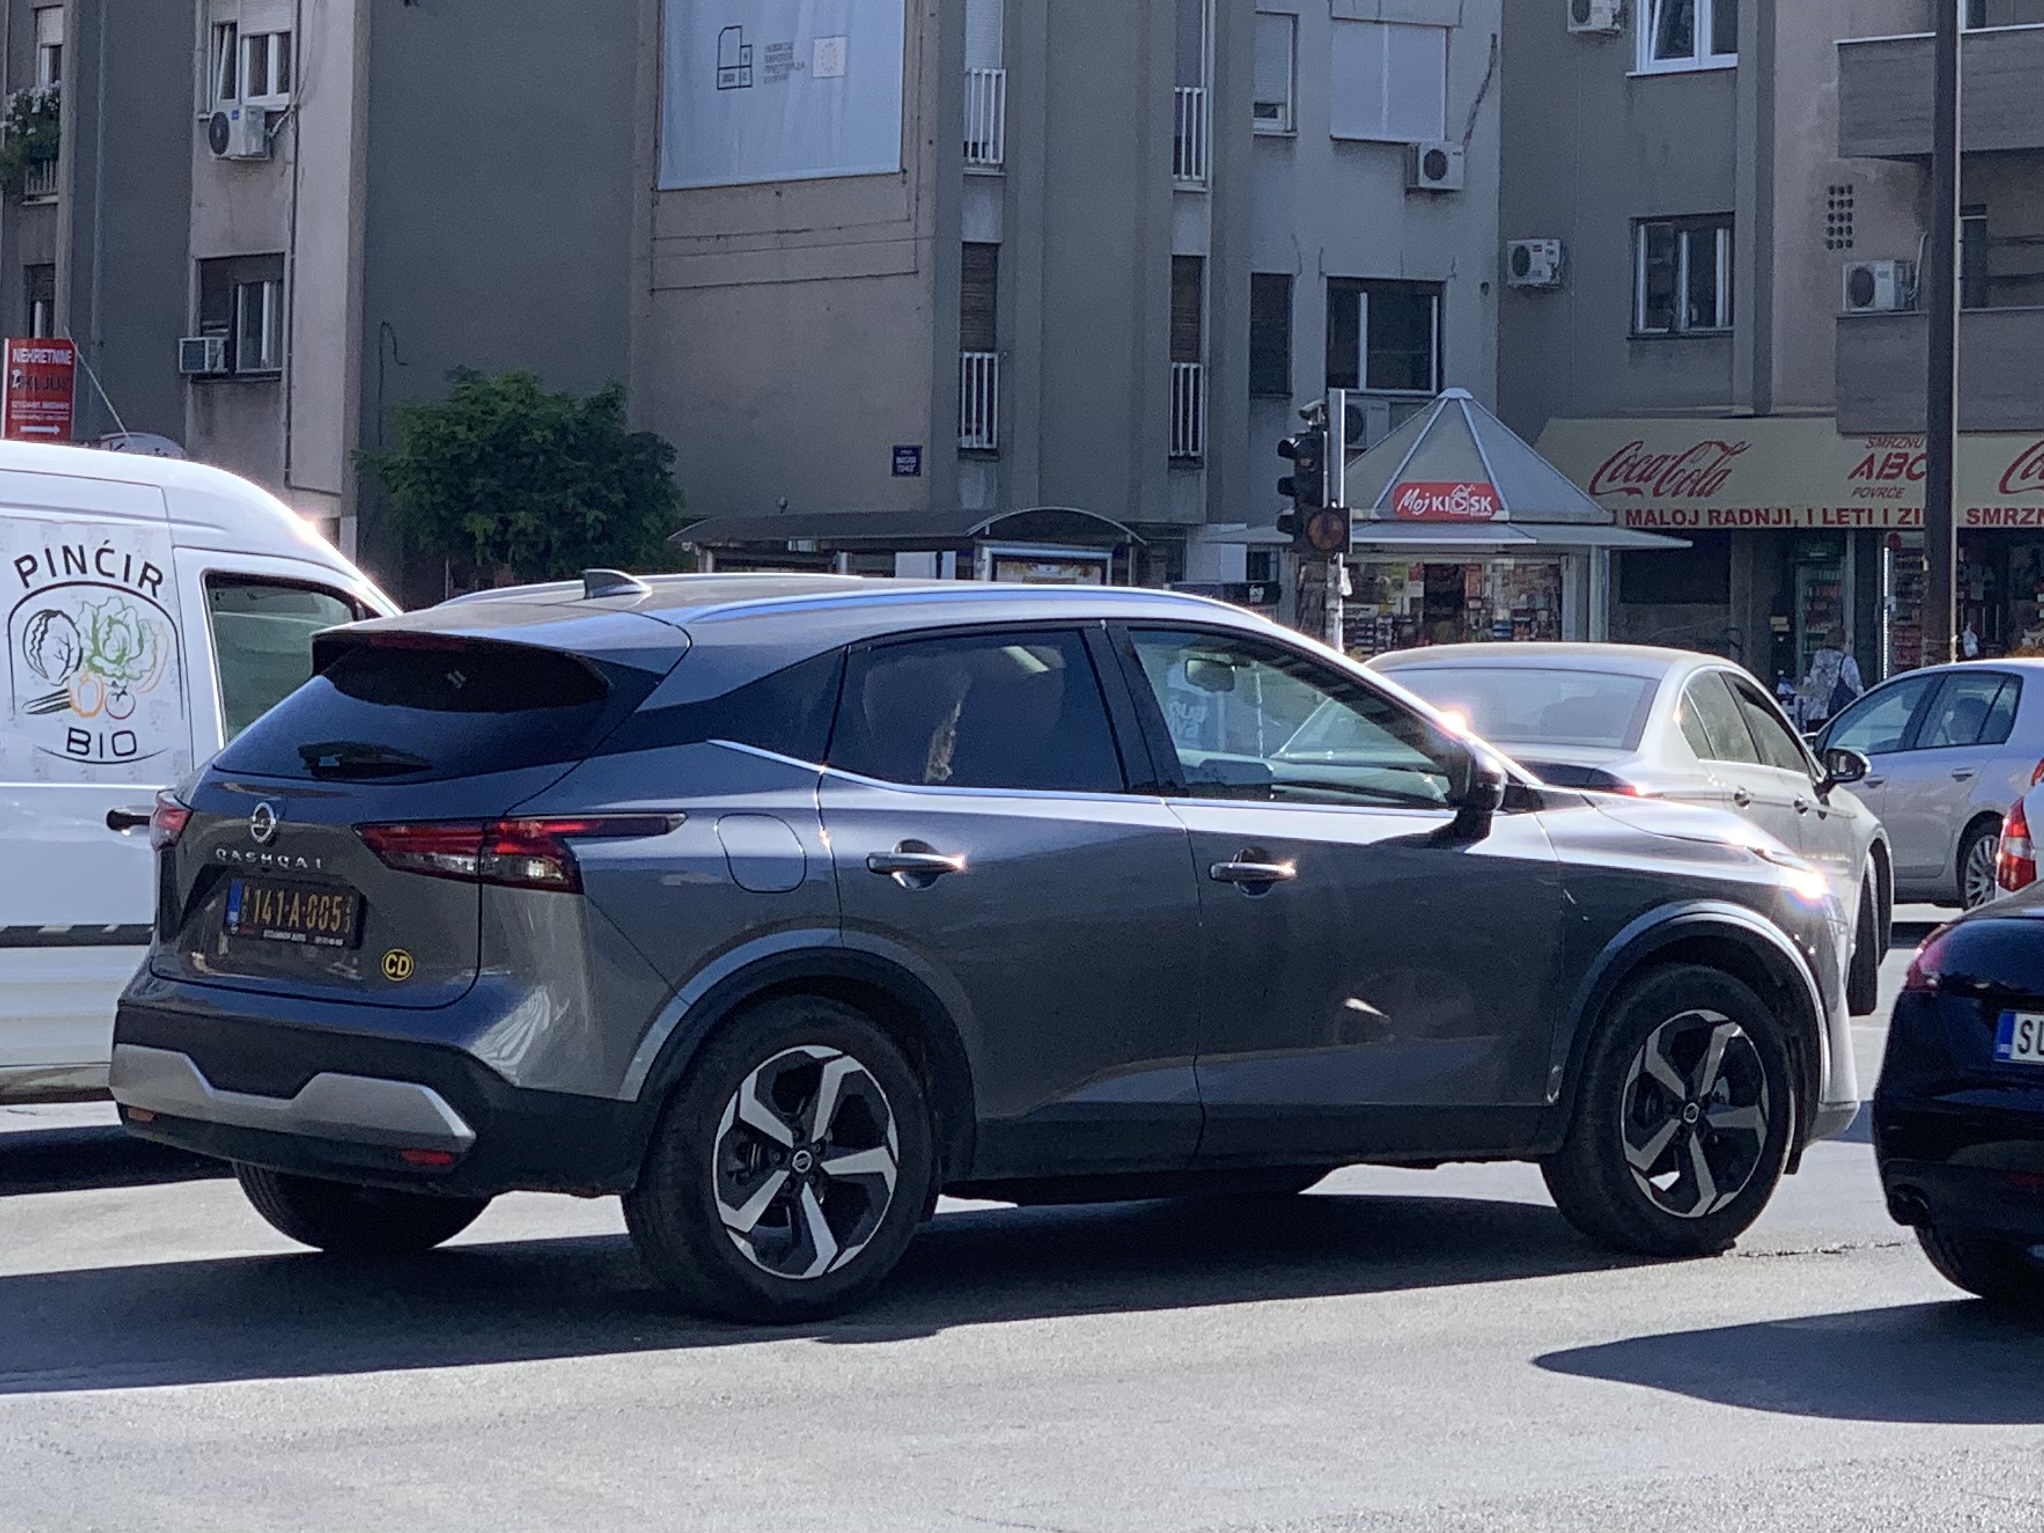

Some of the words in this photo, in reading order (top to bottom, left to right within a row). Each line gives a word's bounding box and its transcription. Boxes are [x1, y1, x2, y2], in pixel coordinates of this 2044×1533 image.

[1847, 452, 1927, 481] ABC
[1396, 488, 1431, 516] Moj
[1431, 487, 1492, 513] KIOSK
[1625, 509, 1699, 526] MALOJ
[1707, 508, 1800, 528] RADNJI,
[1807, 508, 1814, 526] I
[1822, 508, 1874, 526] LETI
[1882, 508, 1889, 525] I
[1898, 508, 1927, 525] ZI
[14, 540, 163, 598] PINĆIR
[66, 727, 137, 758] BIO
[215, 848, 321, 869] QASHQAI
[385, 954, 410, 976] CD
